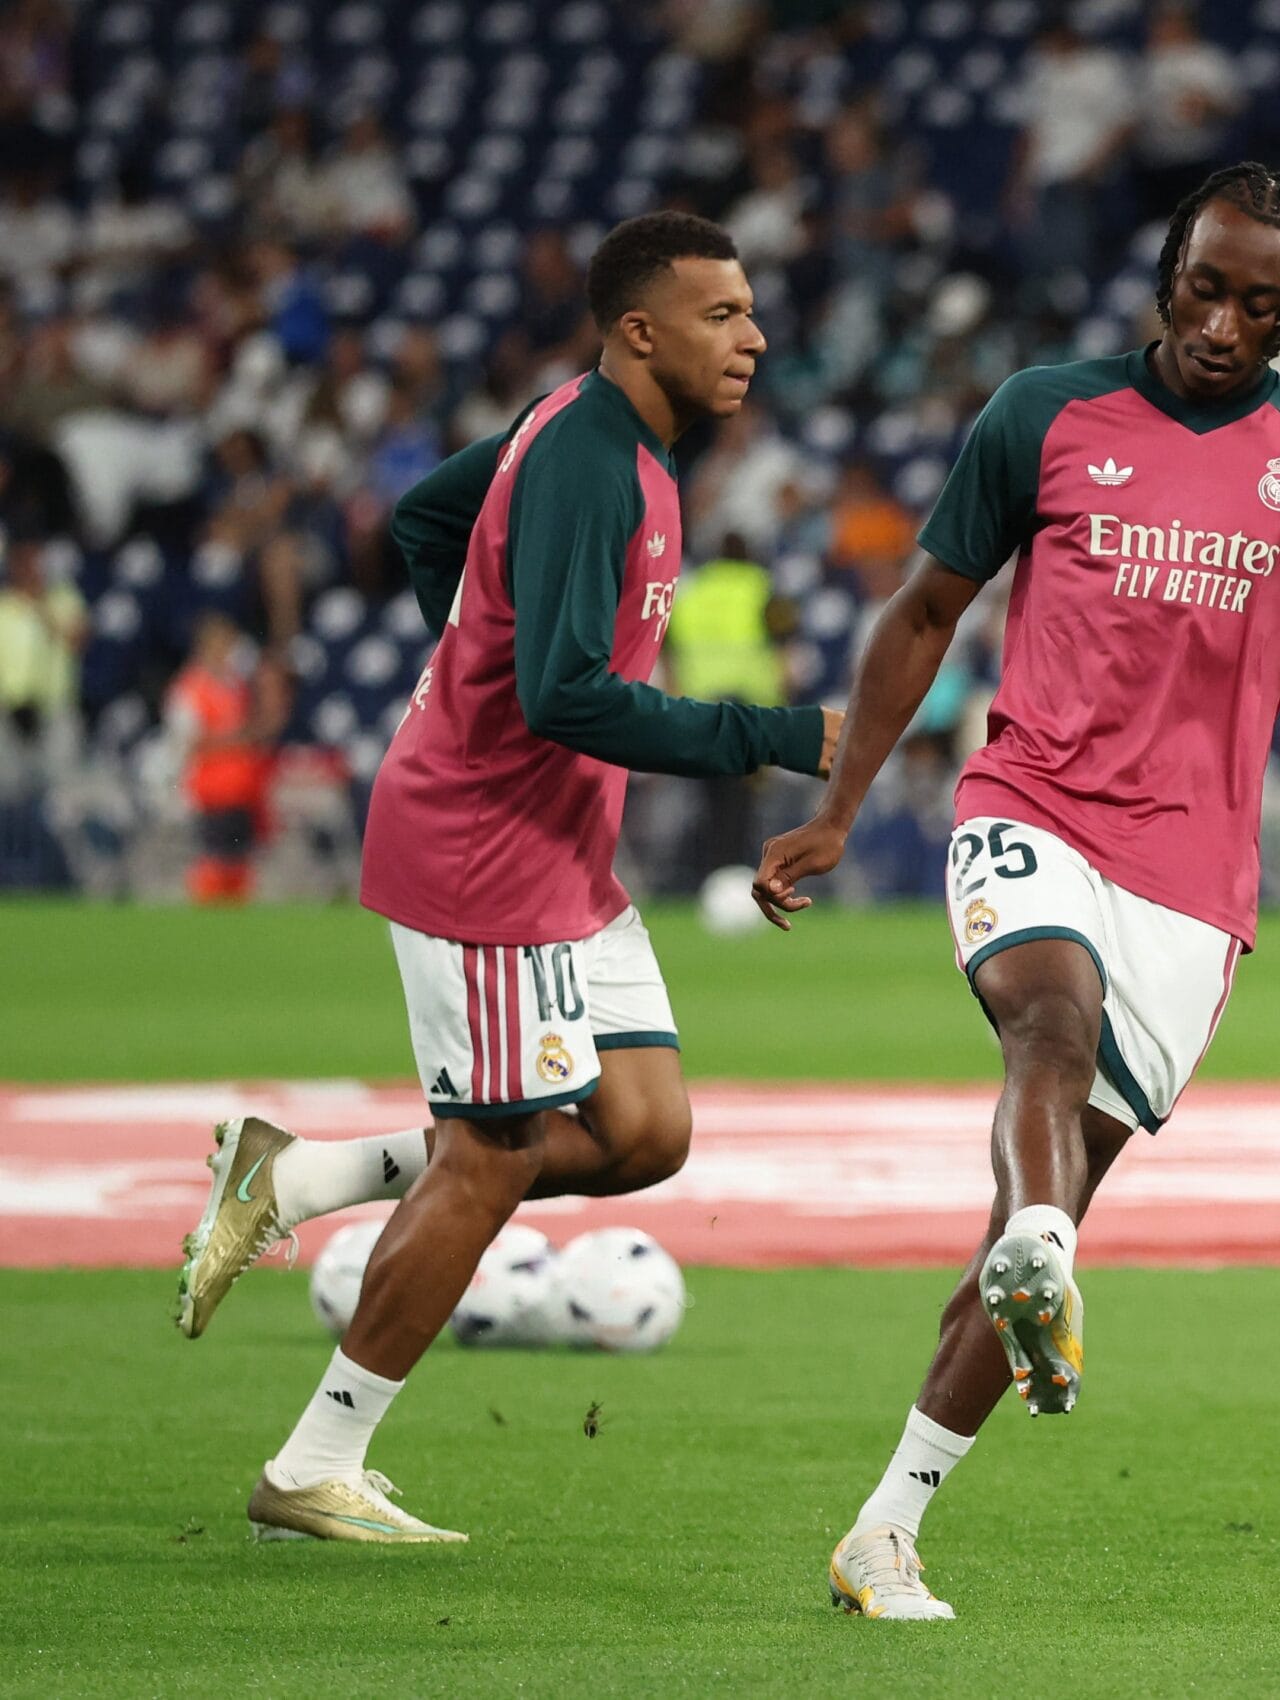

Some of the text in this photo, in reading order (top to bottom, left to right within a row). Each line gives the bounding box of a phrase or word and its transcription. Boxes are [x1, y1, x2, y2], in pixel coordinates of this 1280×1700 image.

[1088, 513, 1280, 577] Emirates
[1113, 563, 1252, 613] FLY BETTER
[952, 822, 1038, 901] 25
[523, 943, 585, 1022] 10
